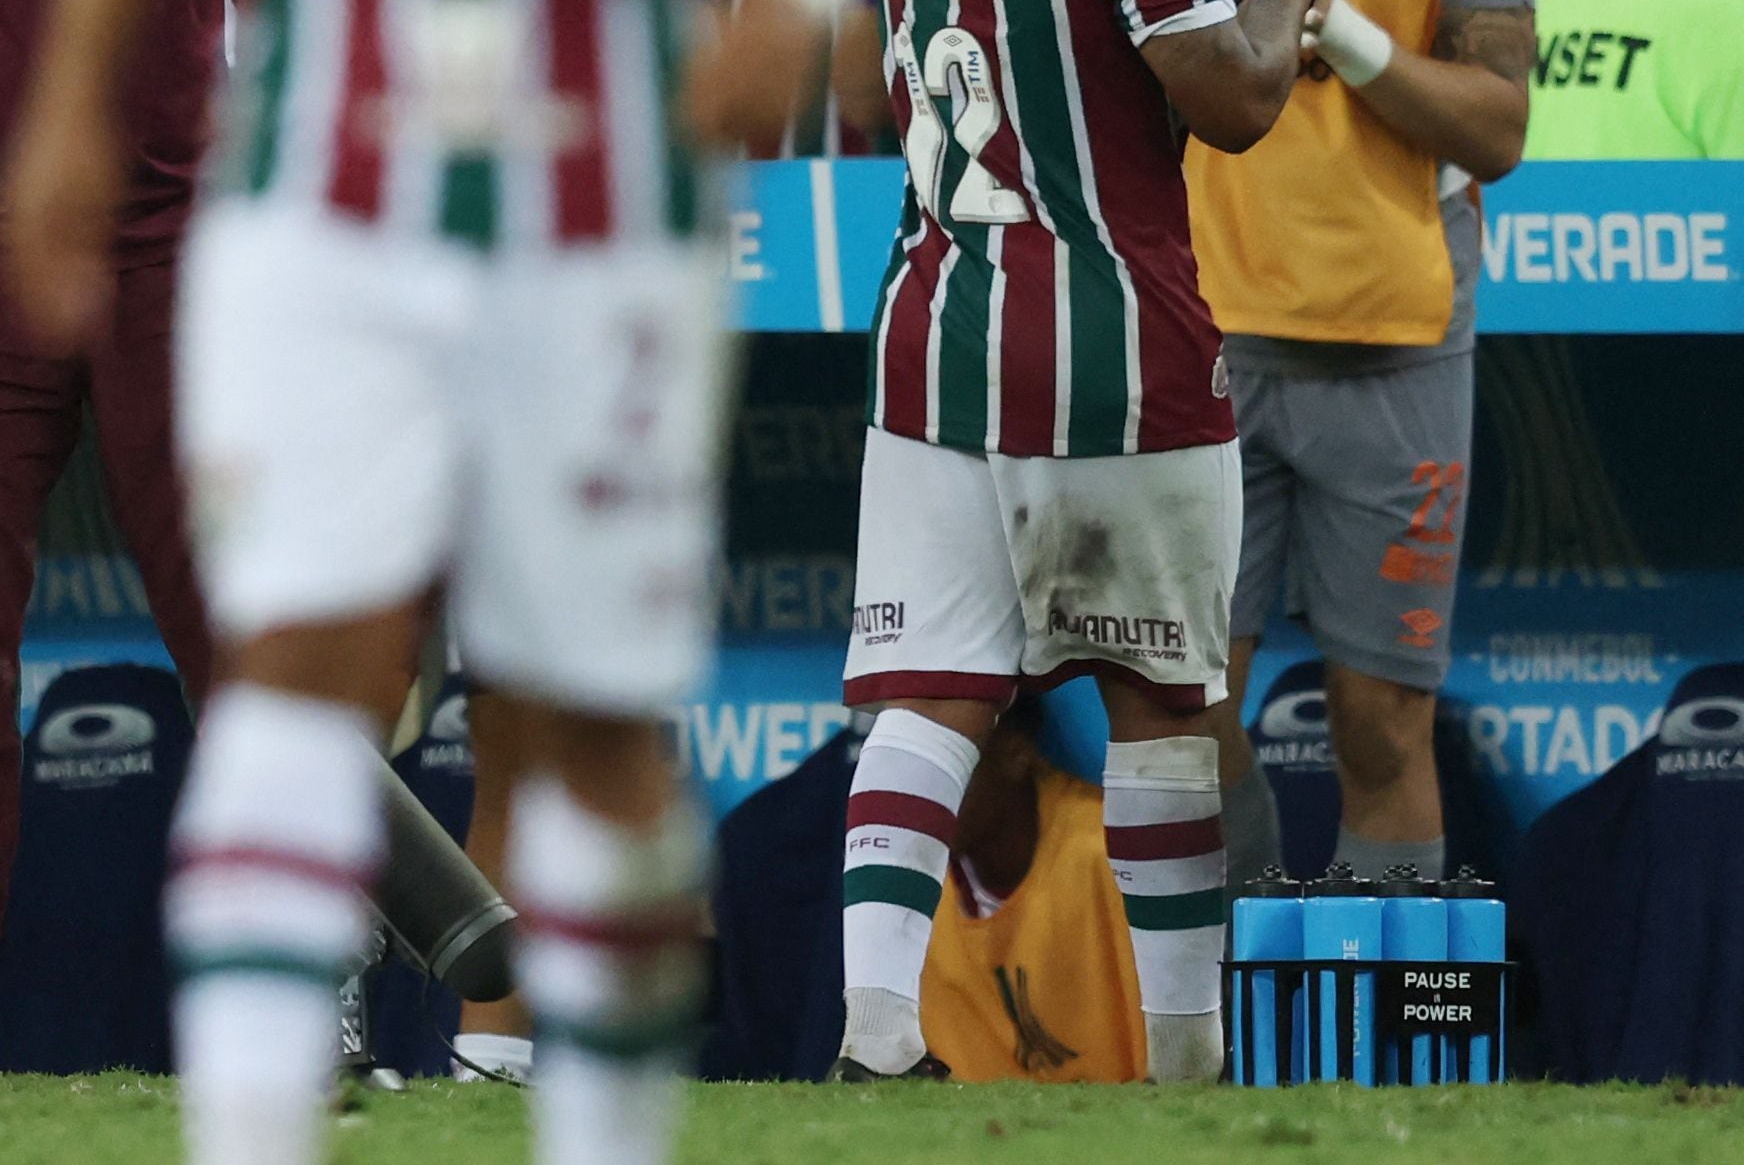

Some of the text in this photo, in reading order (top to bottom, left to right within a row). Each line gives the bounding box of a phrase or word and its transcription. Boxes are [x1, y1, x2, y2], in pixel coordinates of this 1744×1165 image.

[893, 20, 1032, 225] 12
[849, 836, 890, 853] FFC
[1404, 972, 1472, 989] PAUSE
[1403, 1004, 1472, 1022] POWER
